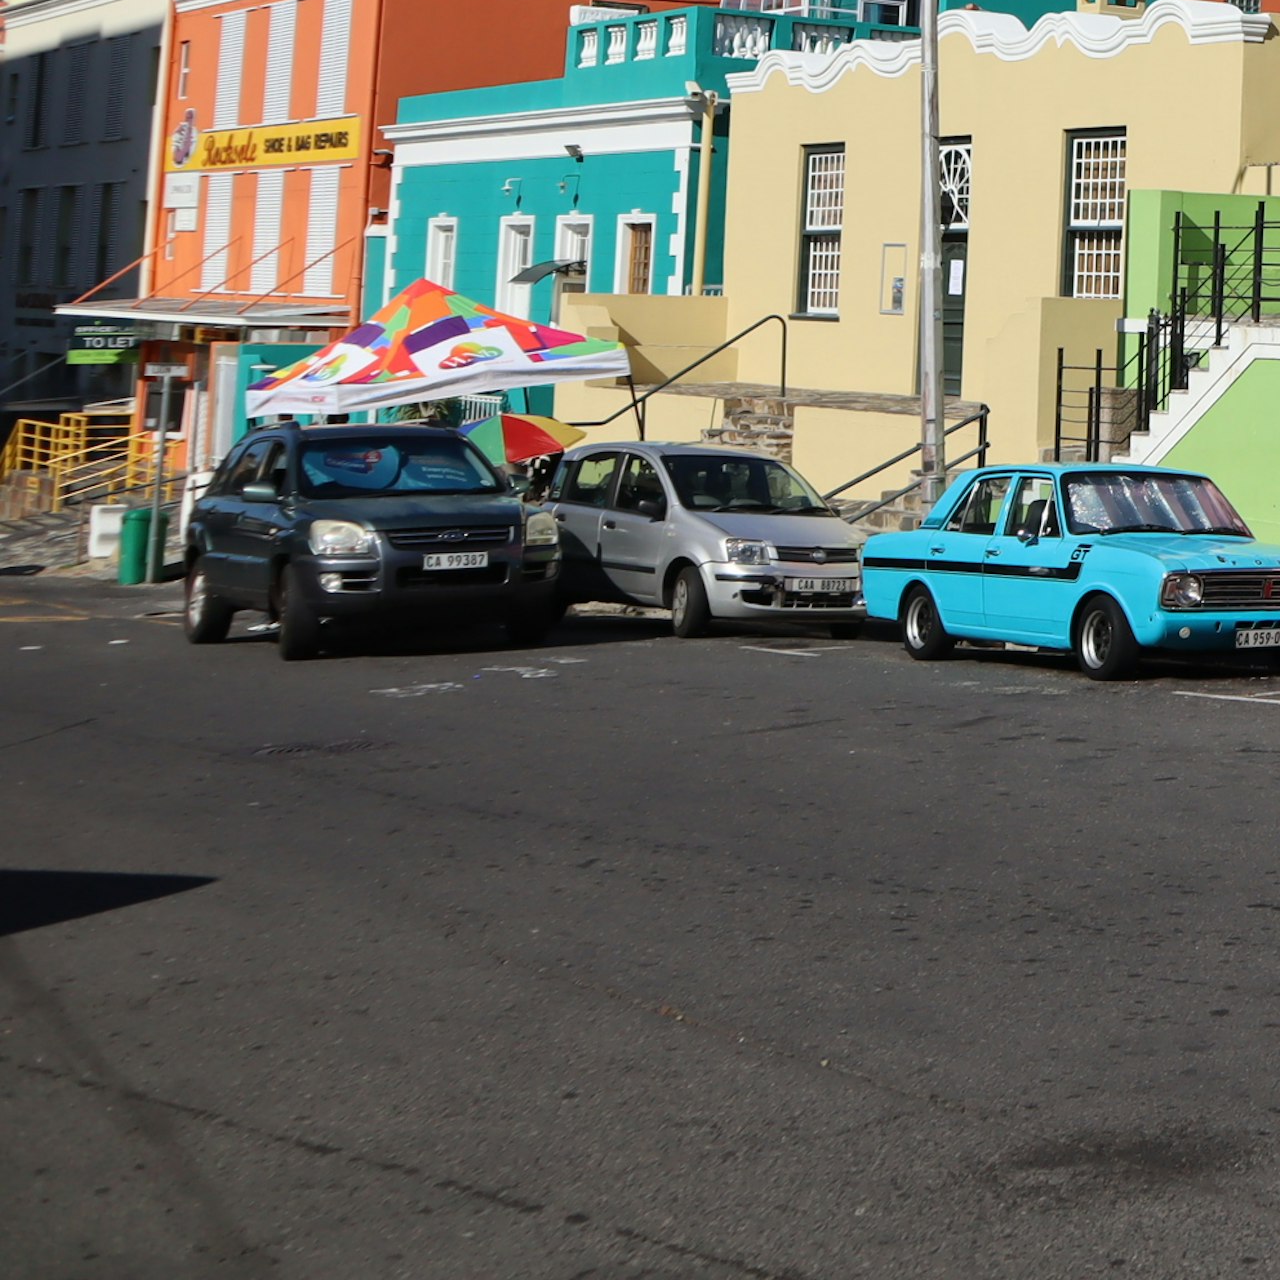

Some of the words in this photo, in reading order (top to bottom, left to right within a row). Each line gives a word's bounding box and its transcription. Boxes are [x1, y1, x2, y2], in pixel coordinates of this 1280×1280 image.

[264, 137, 285, 154] SHOE
[295, 134, 312, 151] BAG
[314, 131, 349, 149] REPAIRS
[83, 337, 104, 348] TO
[108, 337, 135, 348] LET
[1071, 549, 1091, 560] GT
[426, 556, 441, 568] CA
[447, 554, 485, 566] 99387
[798, 580, 814, 590] CAA
[1237, 632, 1250, 646] CA
